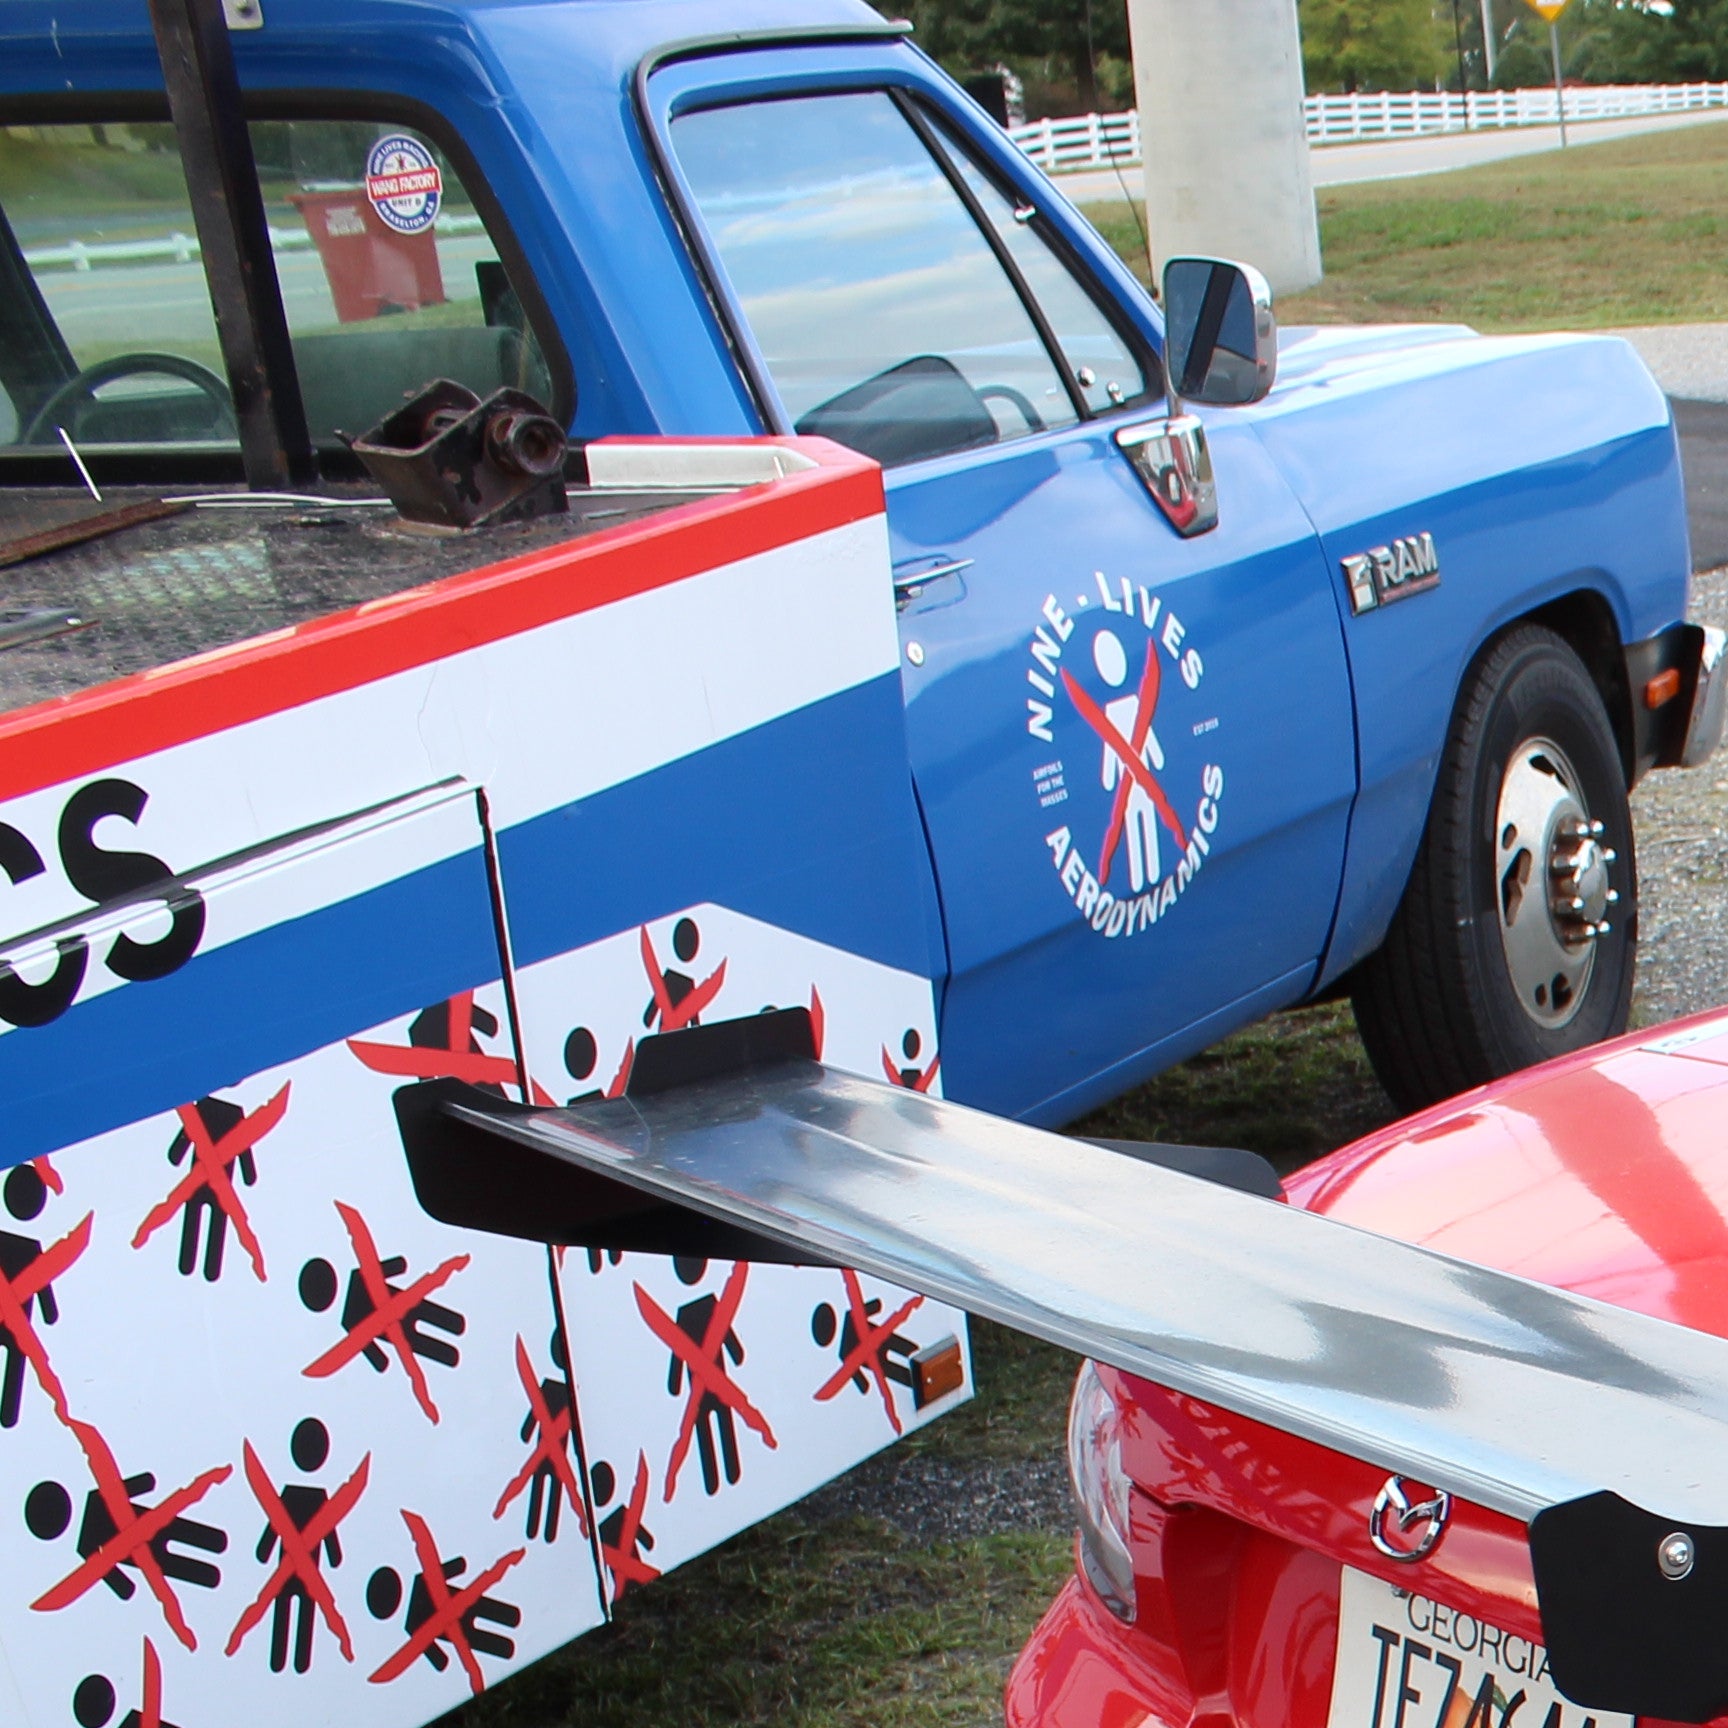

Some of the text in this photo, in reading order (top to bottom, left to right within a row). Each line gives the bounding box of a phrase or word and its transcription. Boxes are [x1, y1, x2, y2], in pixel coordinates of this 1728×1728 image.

[371, 171, 436, 197] WANG FACTORY
[392, 197, 413, 207] UNIT
[1367, 531, 1439, 588] RAM
[1027, 571, 1204, 743] NINE LIVES
[1045, 763, 1224, 938] AERODYNAMICS
